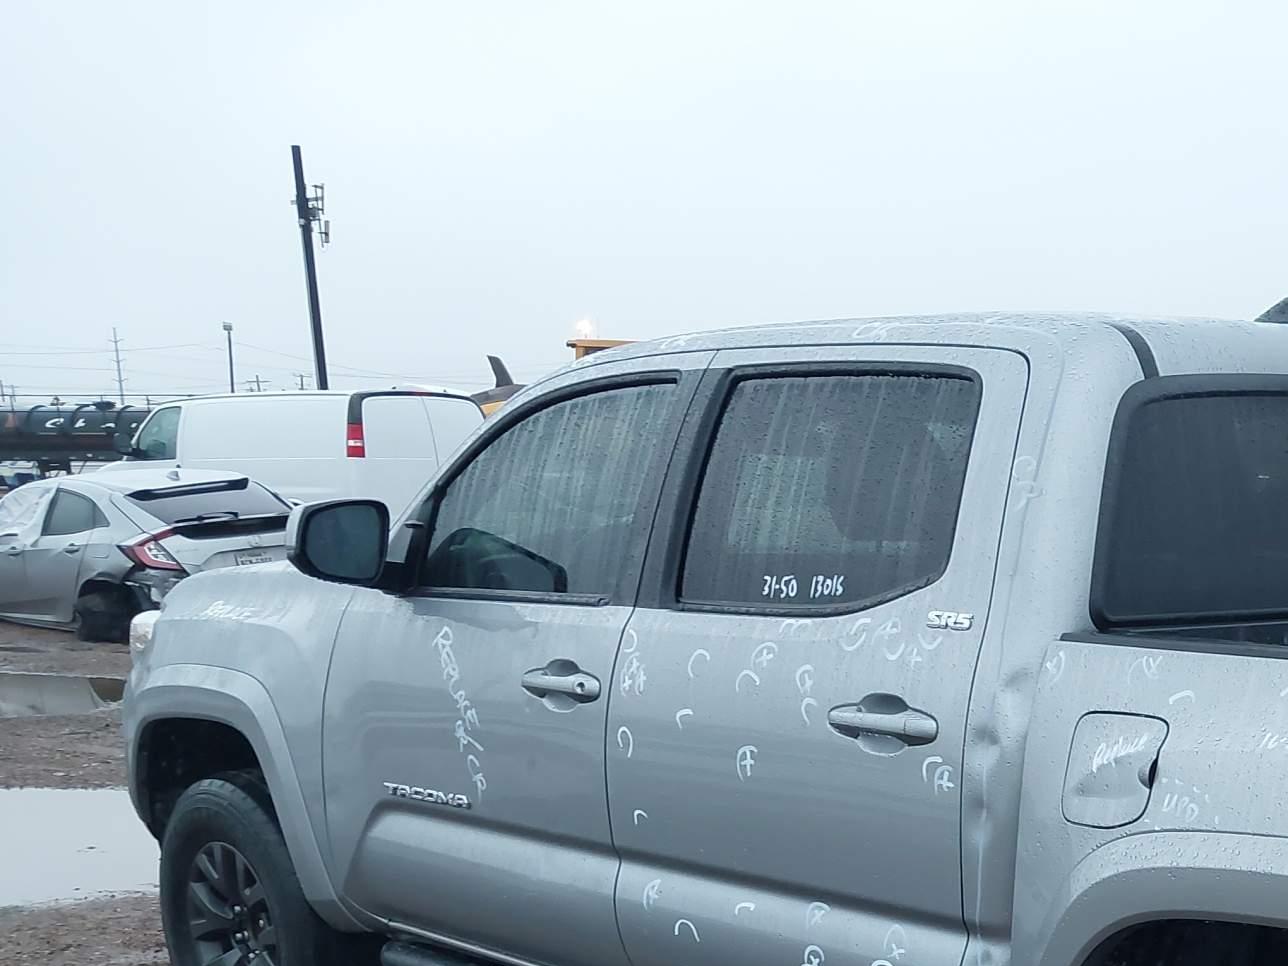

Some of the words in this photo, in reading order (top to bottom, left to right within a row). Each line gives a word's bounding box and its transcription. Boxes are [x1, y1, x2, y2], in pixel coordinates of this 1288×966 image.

[762, 575, 798, 599] 31-50
[926, 610, 974, 632] SR5
[383, 781, 473, 811] TACOMA
